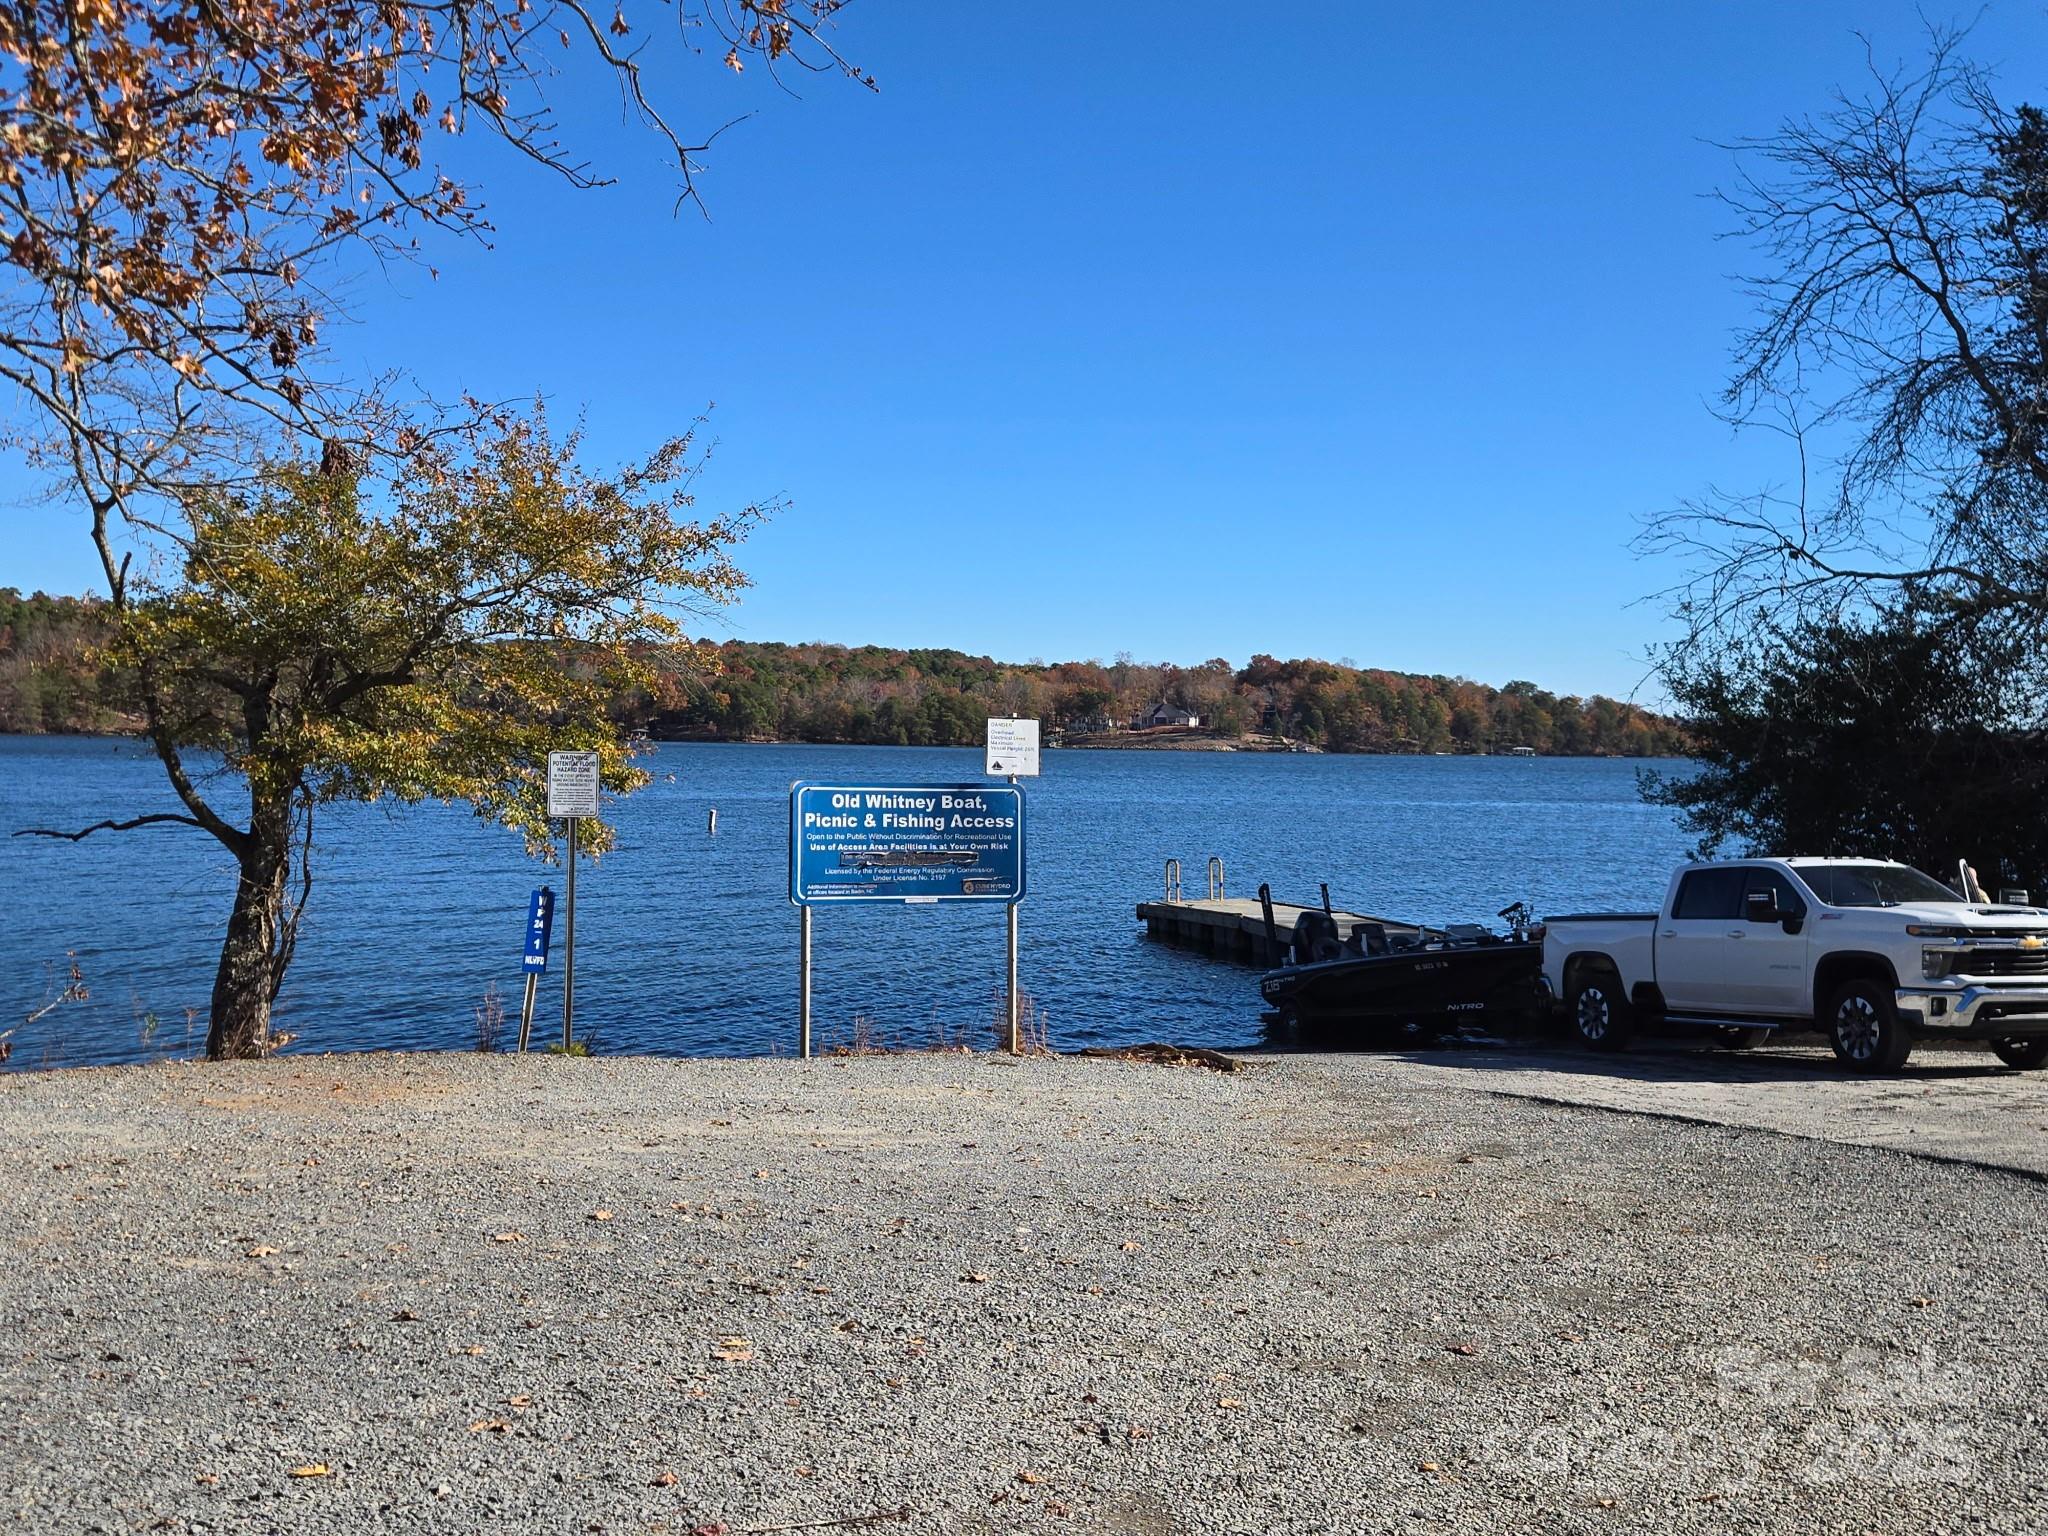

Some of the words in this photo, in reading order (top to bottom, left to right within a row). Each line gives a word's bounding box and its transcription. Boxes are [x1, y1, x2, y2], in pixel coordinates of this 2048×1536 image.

[832, 794, 860, 809] Old
[866, 794, 935, 812] Whitney
[941, 795, 986, 811] Boat,
[805, 813, 858, 828] Picnic
[864, 814, 876, 828] &
[882, 814, 944, 831] Fishing
[950, 814, 1014, 829] Access
[890, 843, 927, 851] Facilities
[854, 868, 861, 876] by
[899, 868, 920, 876] Energy
[922, 868, 955, 876] Regulatory
[533, 920, 544, 928] 24
[534, 938, 540, 950] 1
